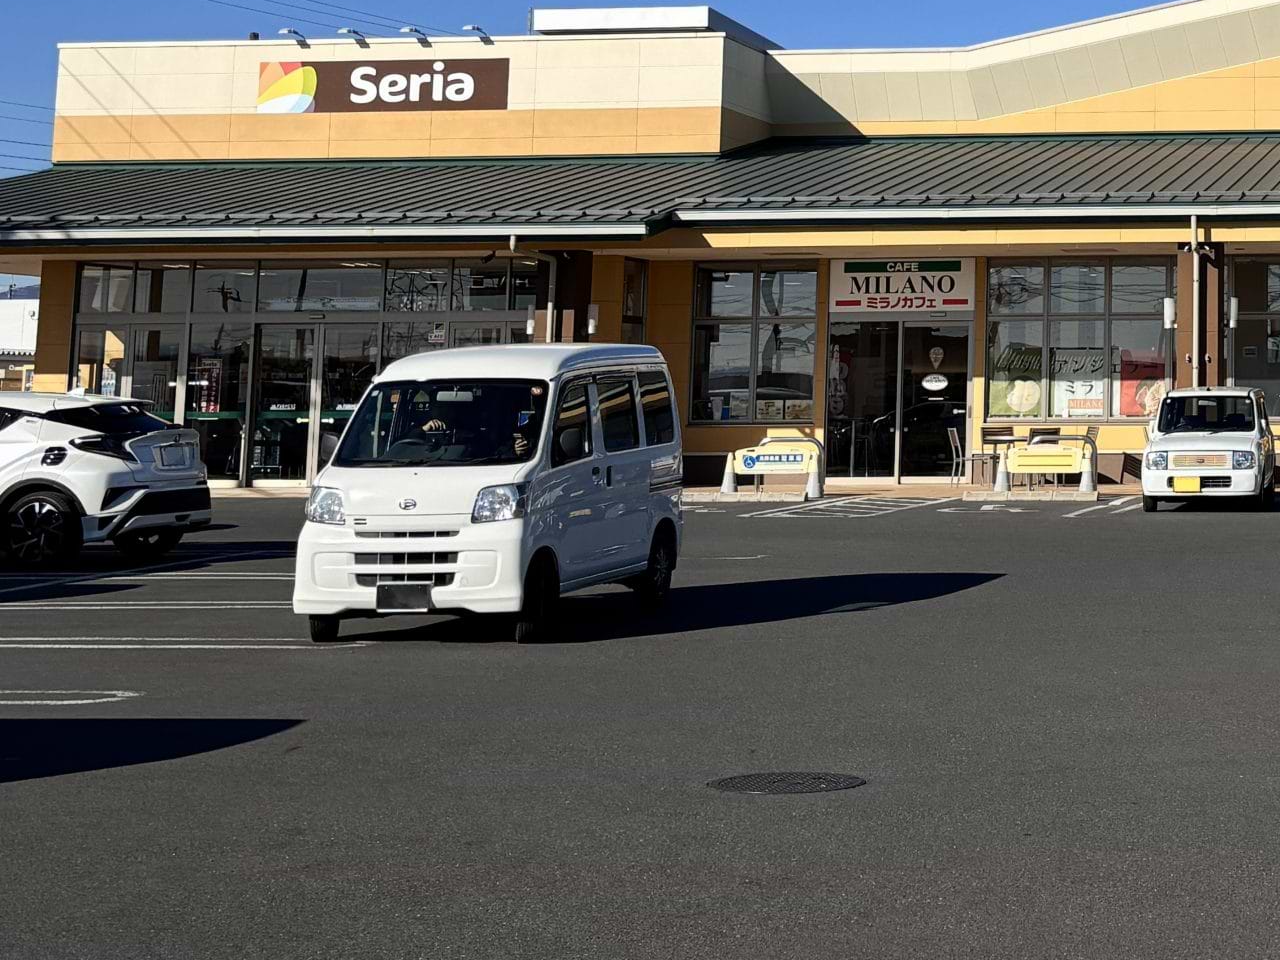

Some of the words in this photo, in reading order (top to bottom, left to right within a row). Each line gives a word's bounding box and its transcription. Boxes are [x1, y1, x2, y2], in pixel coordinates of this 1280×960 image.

[349, 60, 475, 104] Seria
[886, 262, 919, 272] CAFE
[850, 275, 956, 294] MILANO
[866, 296, 937, 309] ミラノカフェ
[1065, 380, 1104, 395] ミラ
